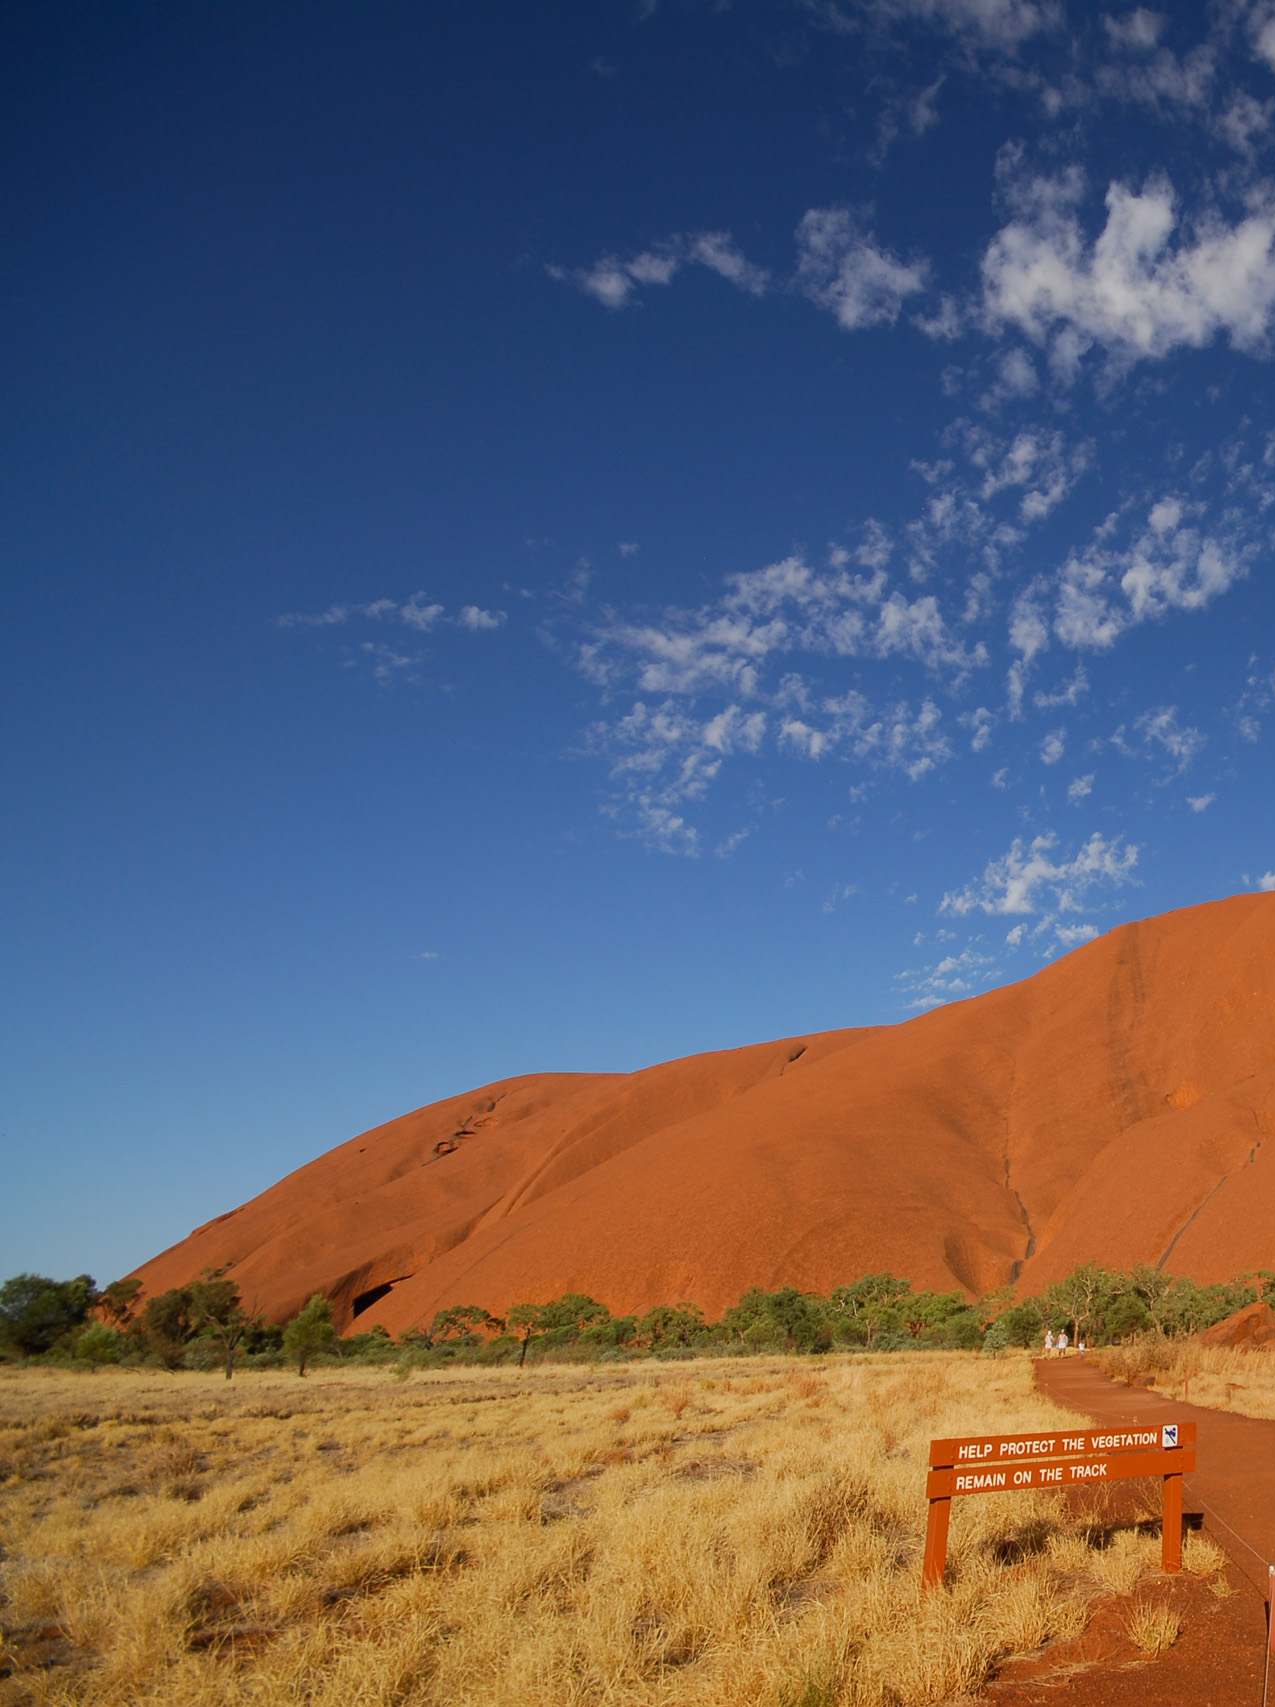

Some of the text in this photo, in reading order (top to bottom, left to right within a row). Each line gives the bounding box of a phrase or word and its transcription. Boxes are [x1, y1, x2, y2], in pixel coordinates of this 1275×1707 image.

[958, 1432, 1158, 1459] HELP PROTECT THE VEGETATION
[955, 1463, 1108, 1490] REMAIN ON THE TRACK
